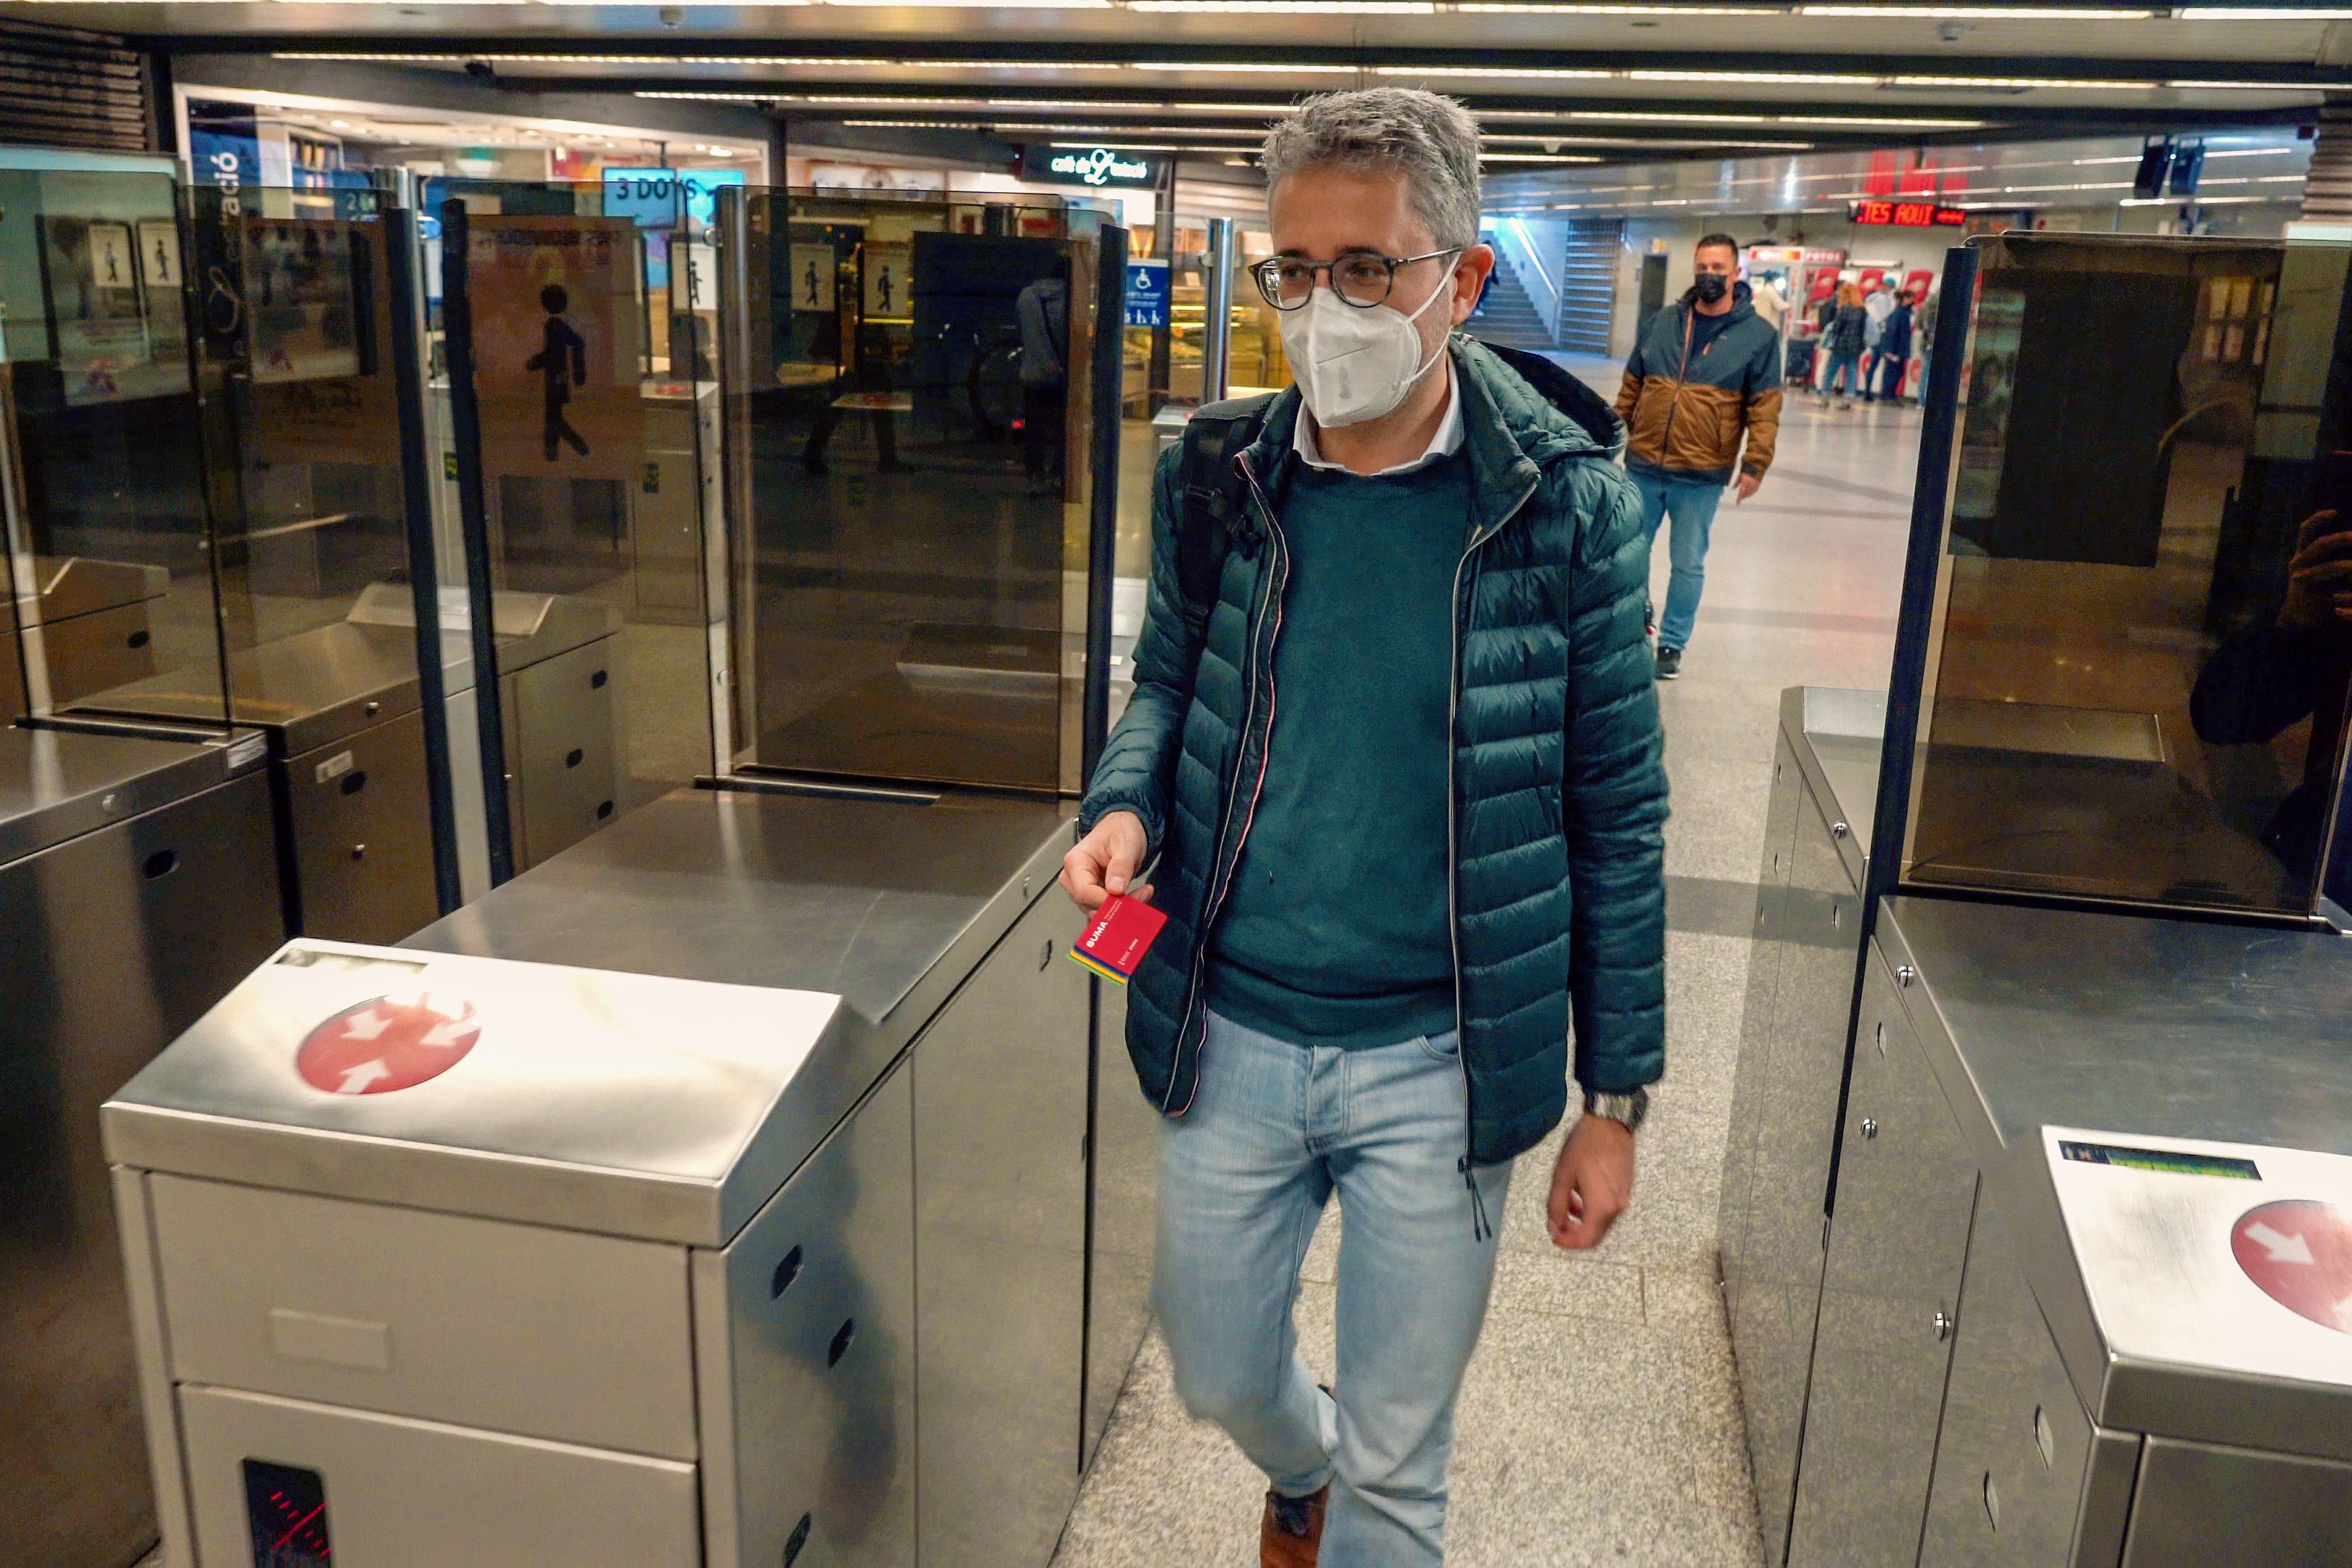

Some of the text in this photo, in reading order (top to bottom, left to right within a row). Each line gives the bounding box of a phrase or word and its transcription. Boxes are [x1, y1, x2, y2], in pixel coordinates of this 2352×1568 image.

[617, 178, 698, 200] 3 DOS
[1086, 921, 1108, 948] SUMA
